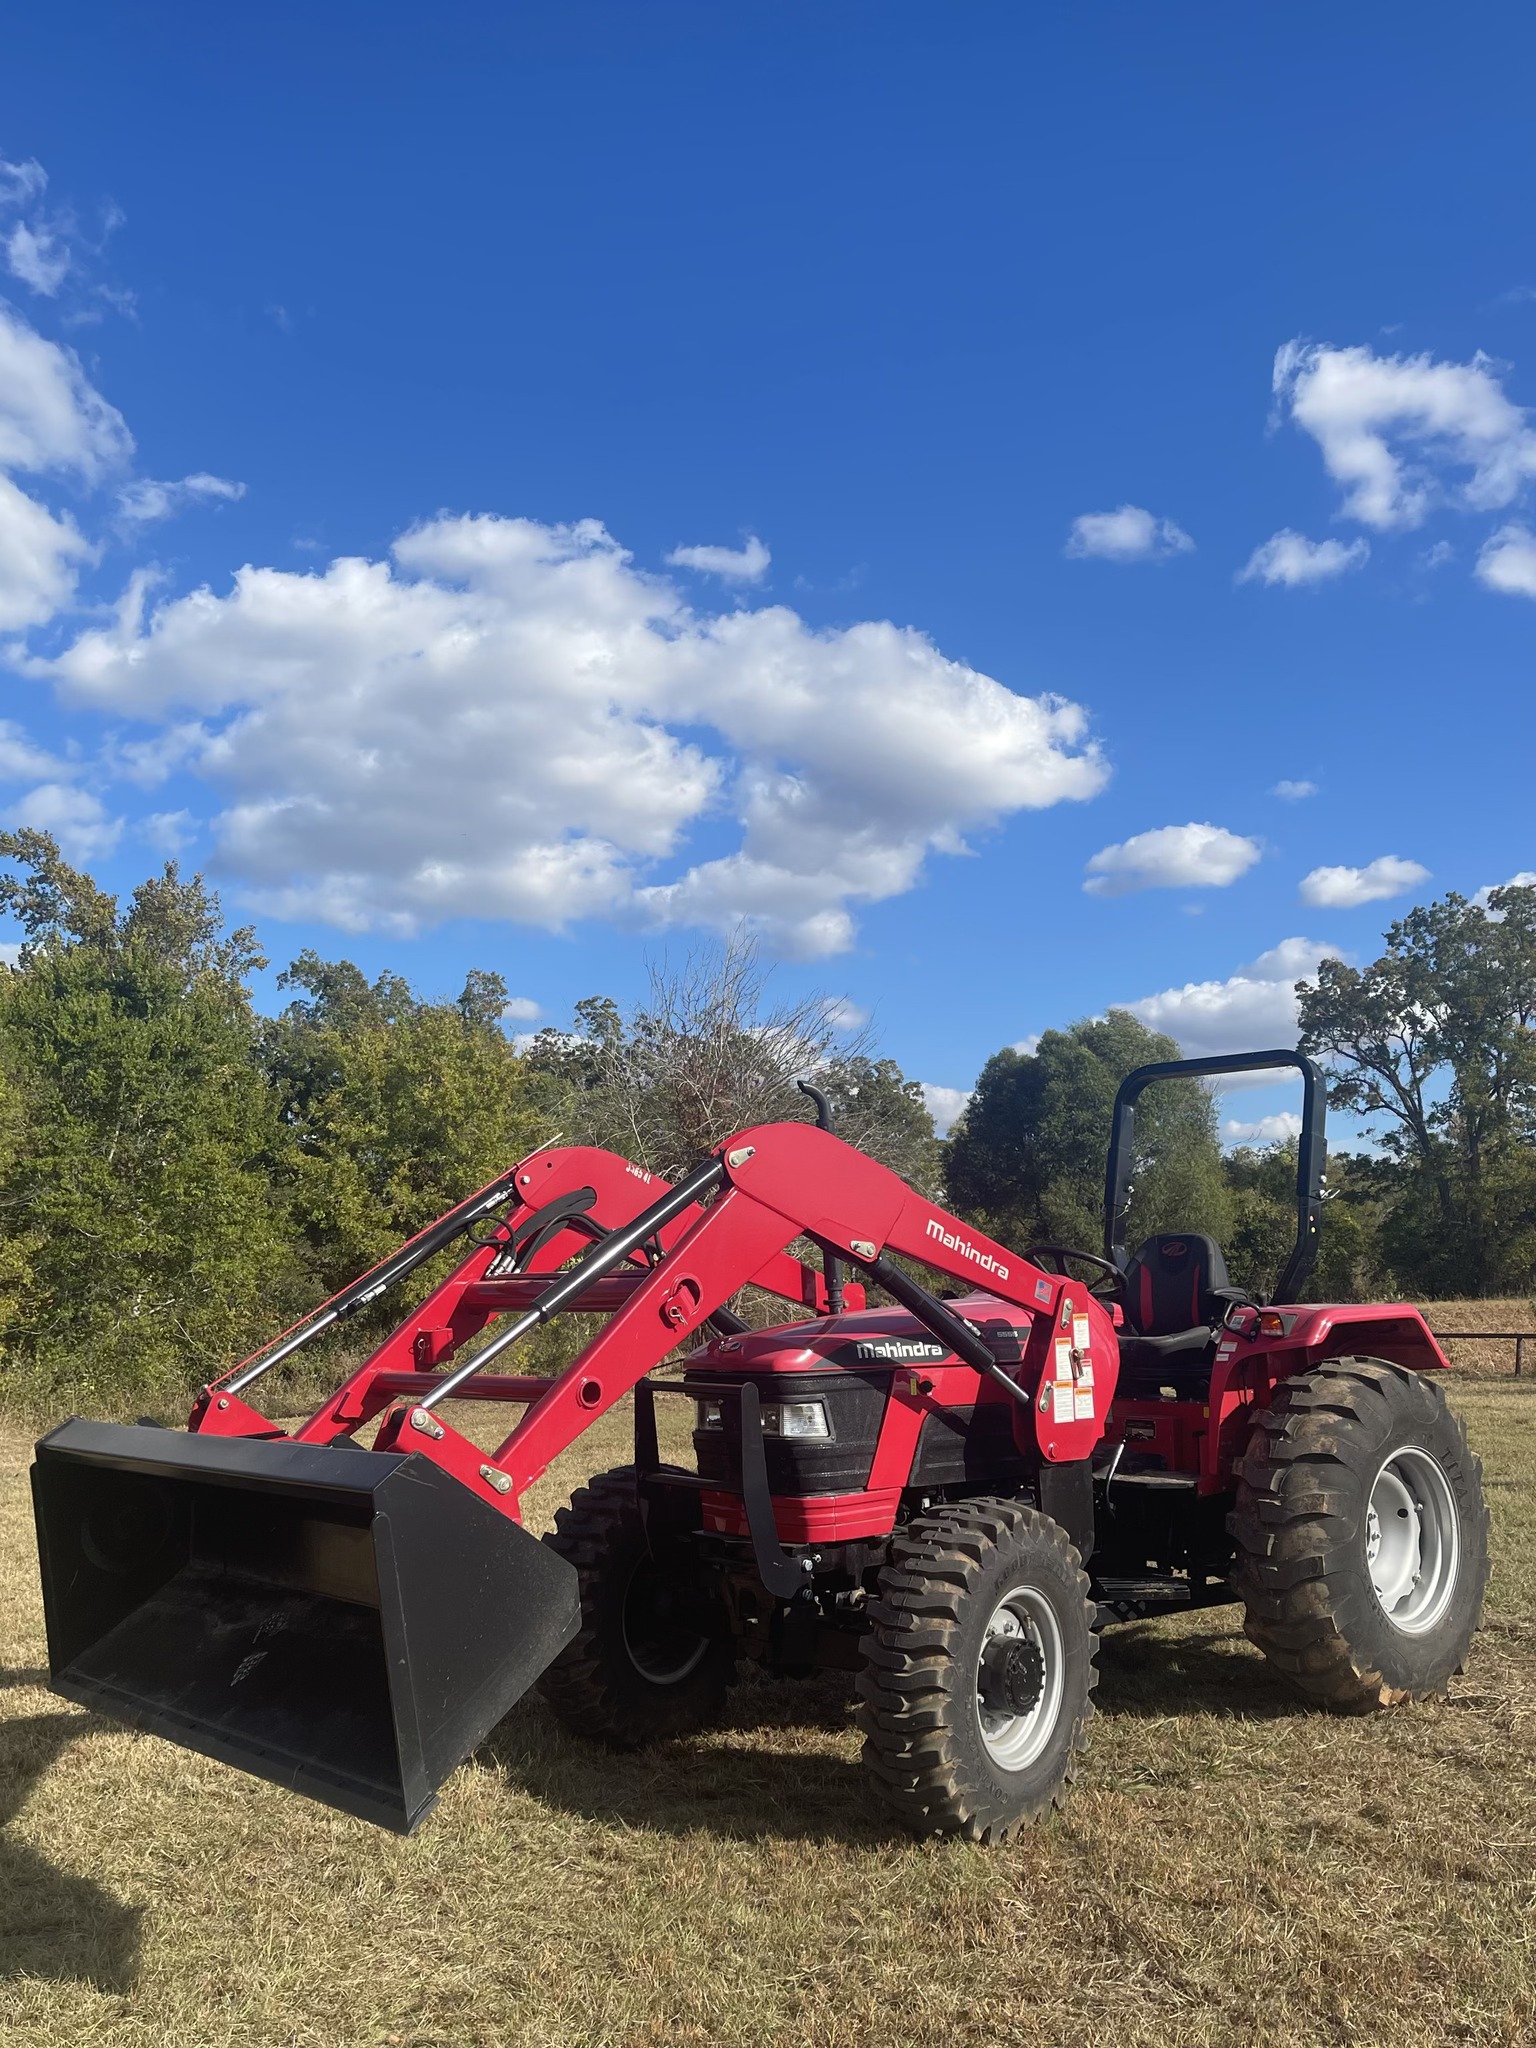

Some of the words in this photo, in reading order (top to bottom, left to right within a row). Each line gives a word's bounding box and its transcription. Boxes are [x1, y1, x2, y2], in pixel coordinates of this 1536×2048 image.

[926, 1219, 1009, 1280] Mahindra
[857, 1342, 943, 1359] Mahindra
[1440, 1447, 1474, 1523] TITAN
